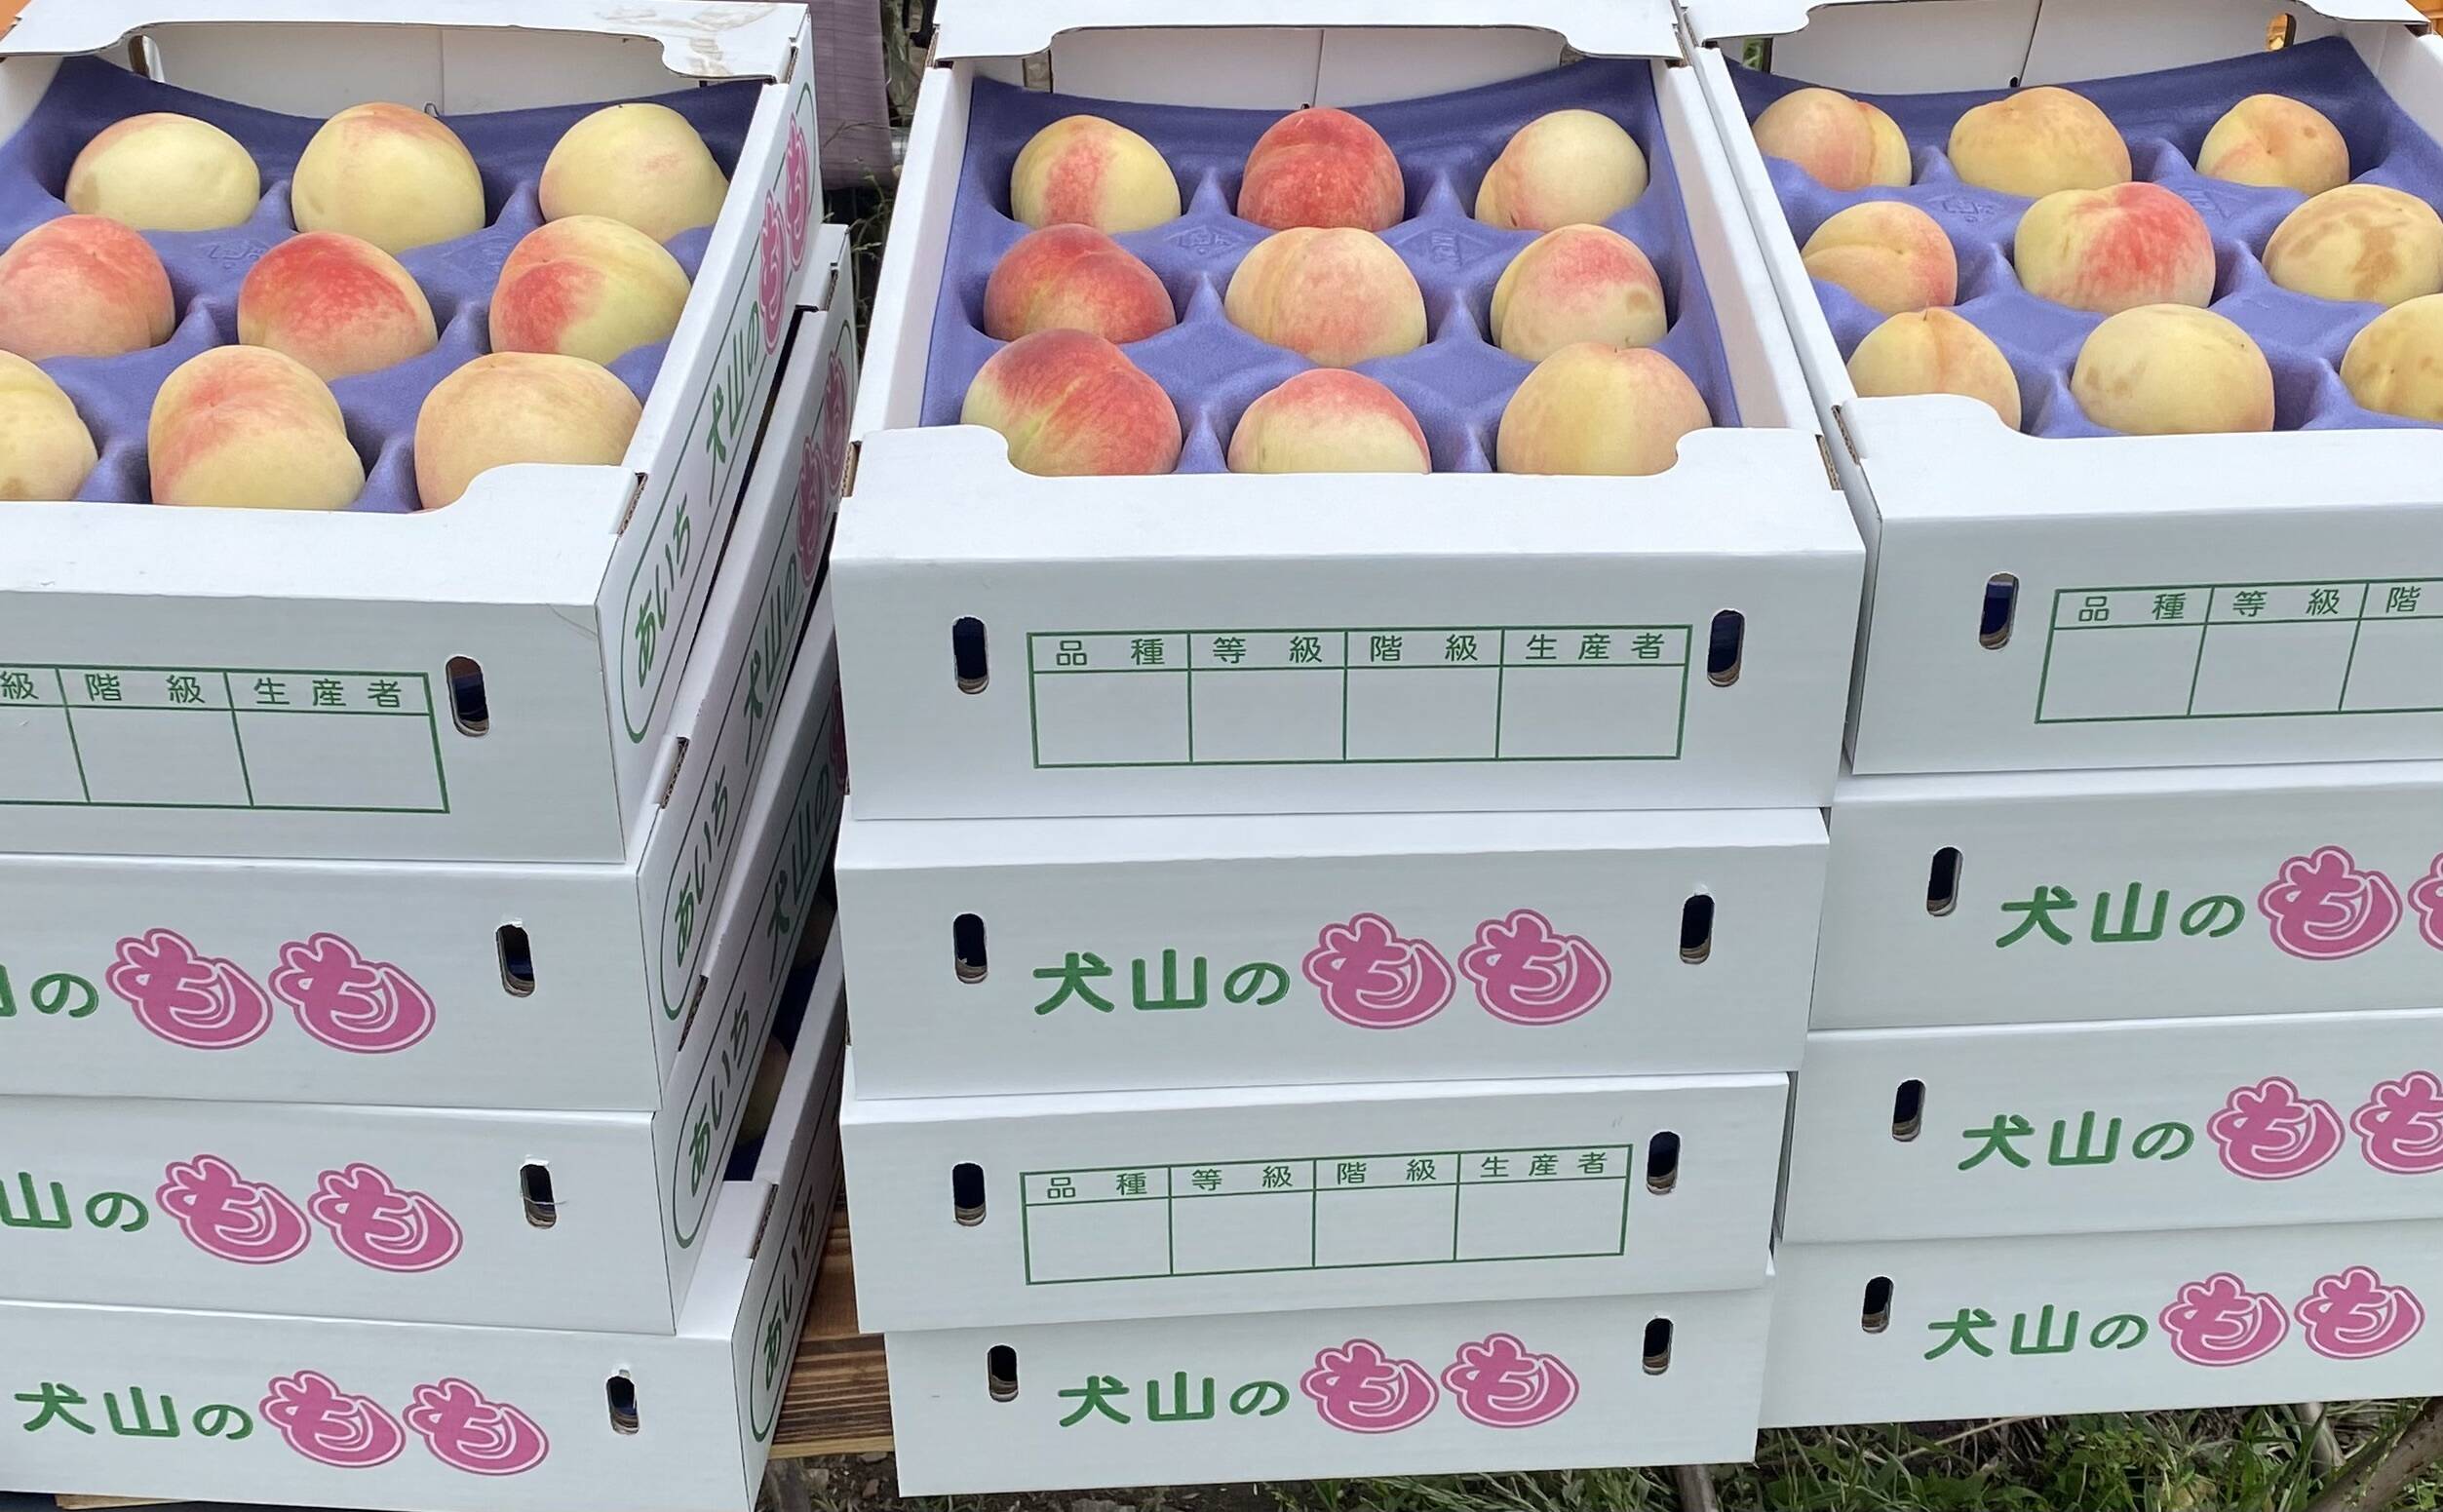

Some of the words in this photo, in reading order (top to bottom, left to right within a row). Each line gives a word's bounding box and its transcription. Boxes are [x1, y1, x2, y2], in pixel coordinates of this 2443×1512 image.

[636, 491, 691, 688] あいち
[707, 111, 810, 507] 犬山のもも
[1055, 636, 1166, 668] 品種
[1212, 635, 1324, 666] 等級
[1370, 633, 1479, 664] 階級
[1525, 632, 1666, 662] 生産者
[2078, 590, 2187, 622] 品種
[2232, 587, 2340, 617] 等級
[2385, 585, 2421, 614] 階
[84, 673, 206, 704] 階級
[252, 677, 403, 709] 生産者
[675, 764, 728, 968] あいち
[1997, 846, 2443, 958] 犬山のも
[0, 928, 436, 1053] のもも
[1034, 909, 1611, 1029] 犬山のもも
[688, 990, 749, 1195] あいち
[1047, 1171, 1147, 1200] 品種
[1191, 1166, 1295, 1192] 等級
[1337, 1158, 1437, 1184] 階級
[1479, 1151, 1609, 1179] 生産者
[763, 1184, 817, 1391] あいち
[1924, 1266, 2425, 1367] 犬山のもも
[16, 1370, 548, 1474] 犬山のもも
[1058, 1333, 1579, 1434] 犬山のもも
